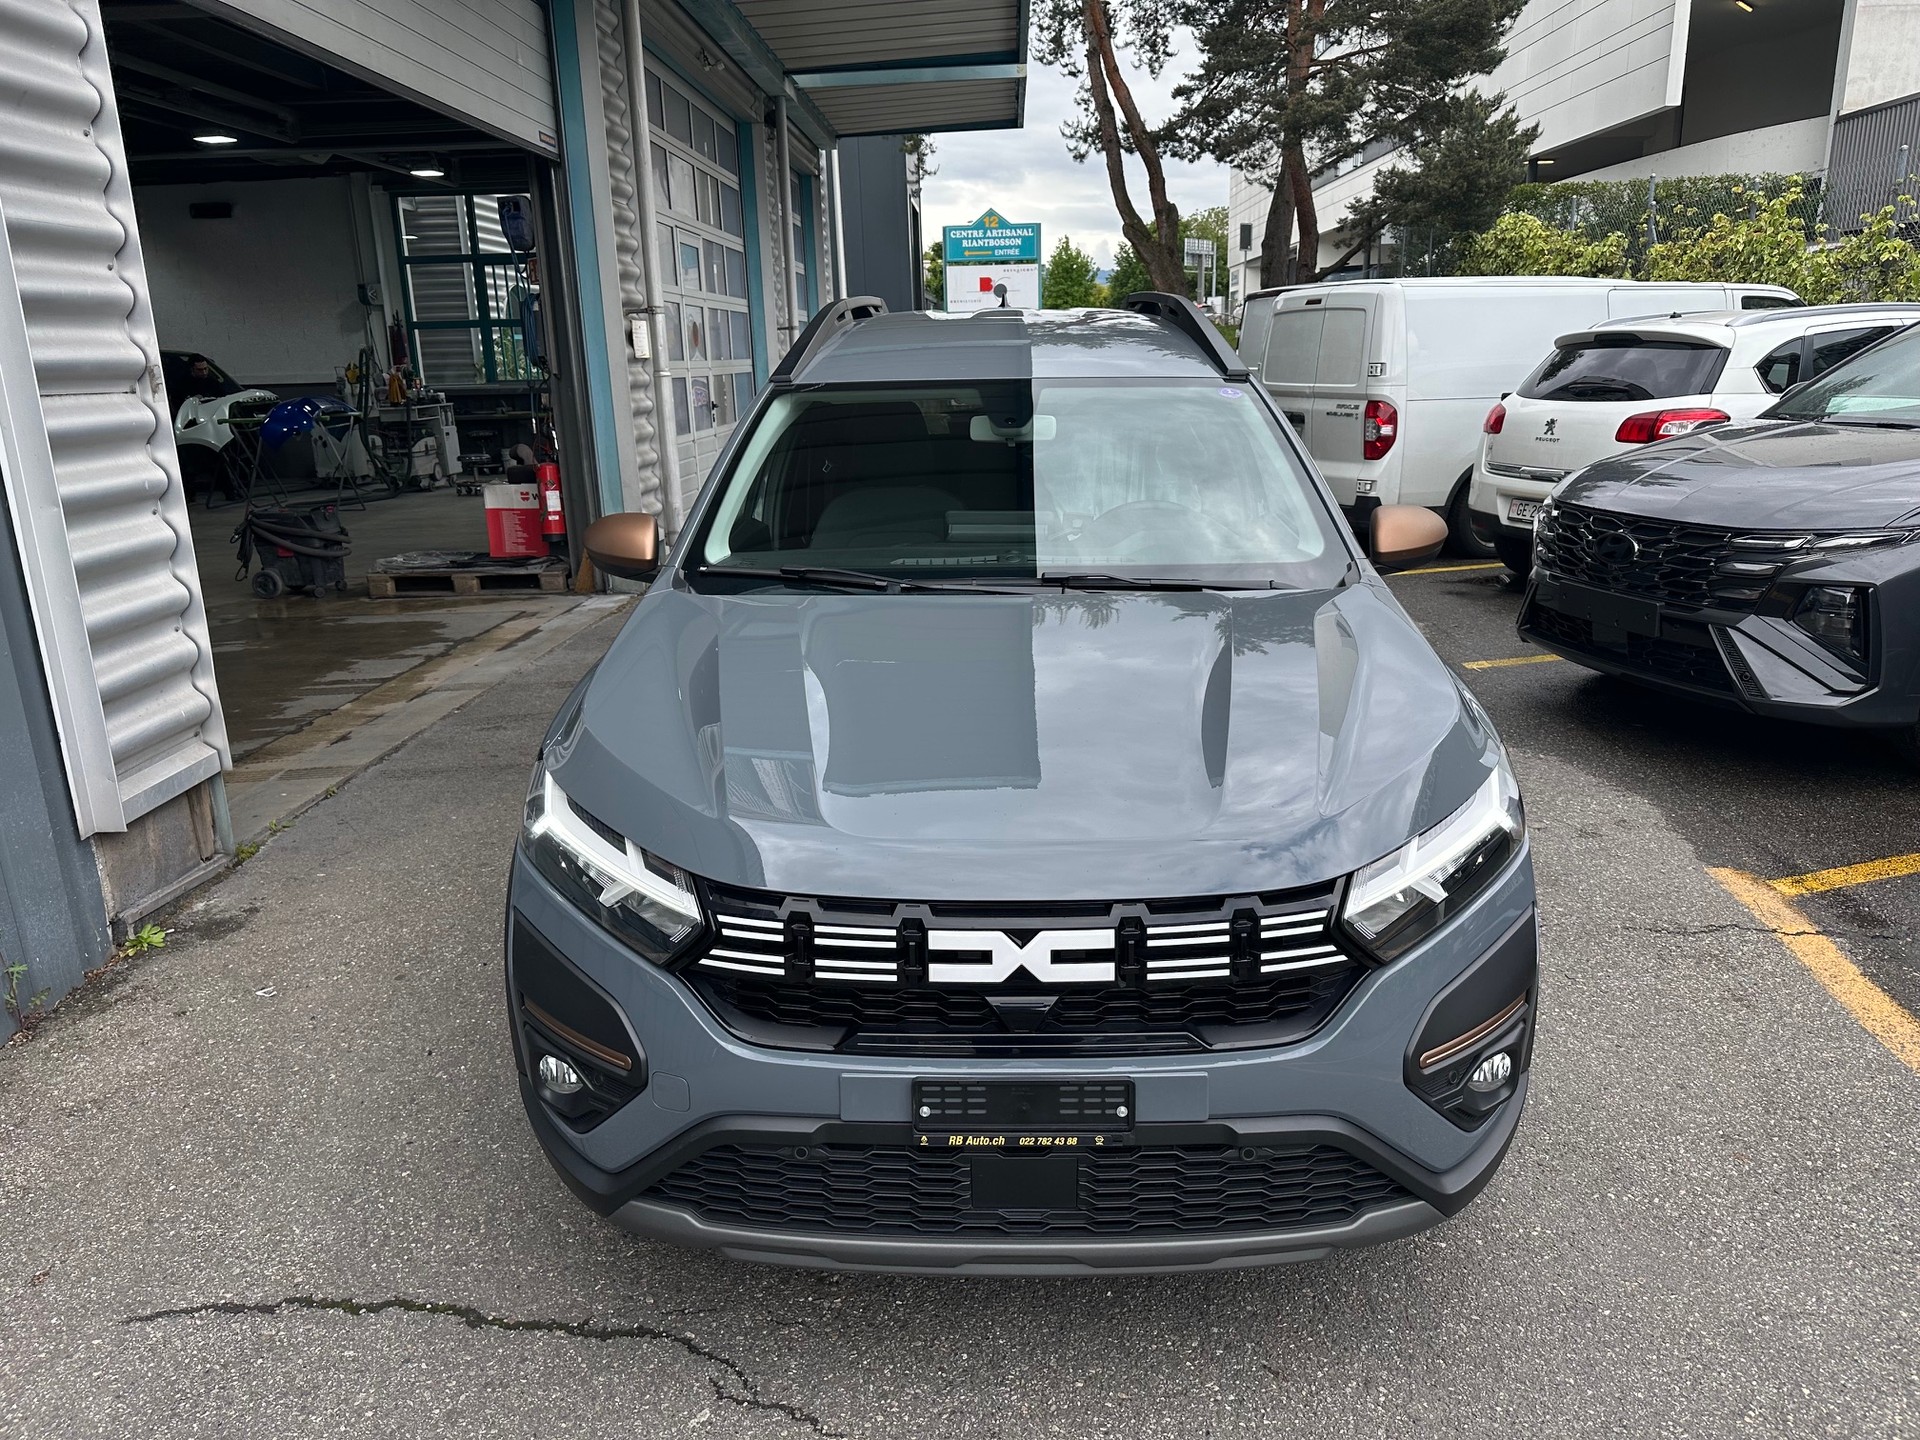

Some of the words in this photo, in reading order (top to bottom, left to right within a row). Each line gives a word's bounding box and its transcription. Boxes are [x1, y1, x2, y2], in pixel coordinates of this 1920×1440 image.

[983, 215, 999, 228] 12
[950, 229, 984, 238] CENTRE
[985, 228, 1034, 237] ARTISANAL
[962, 238, 1022, 247] RIANTBOSSON
[994, 247, 1020, 256] ENTRÉE
[948, 1135, 963, 1146] RB
[965, 1135, 1005, 1146] Auto.ch
[1019, 1136, 1035, 1146] 022
[1037, 1136, 1052, 1146] 782
[1053, 1136, 1065, 1146] 43
[1066, 1136, 1078, 1146] 88
